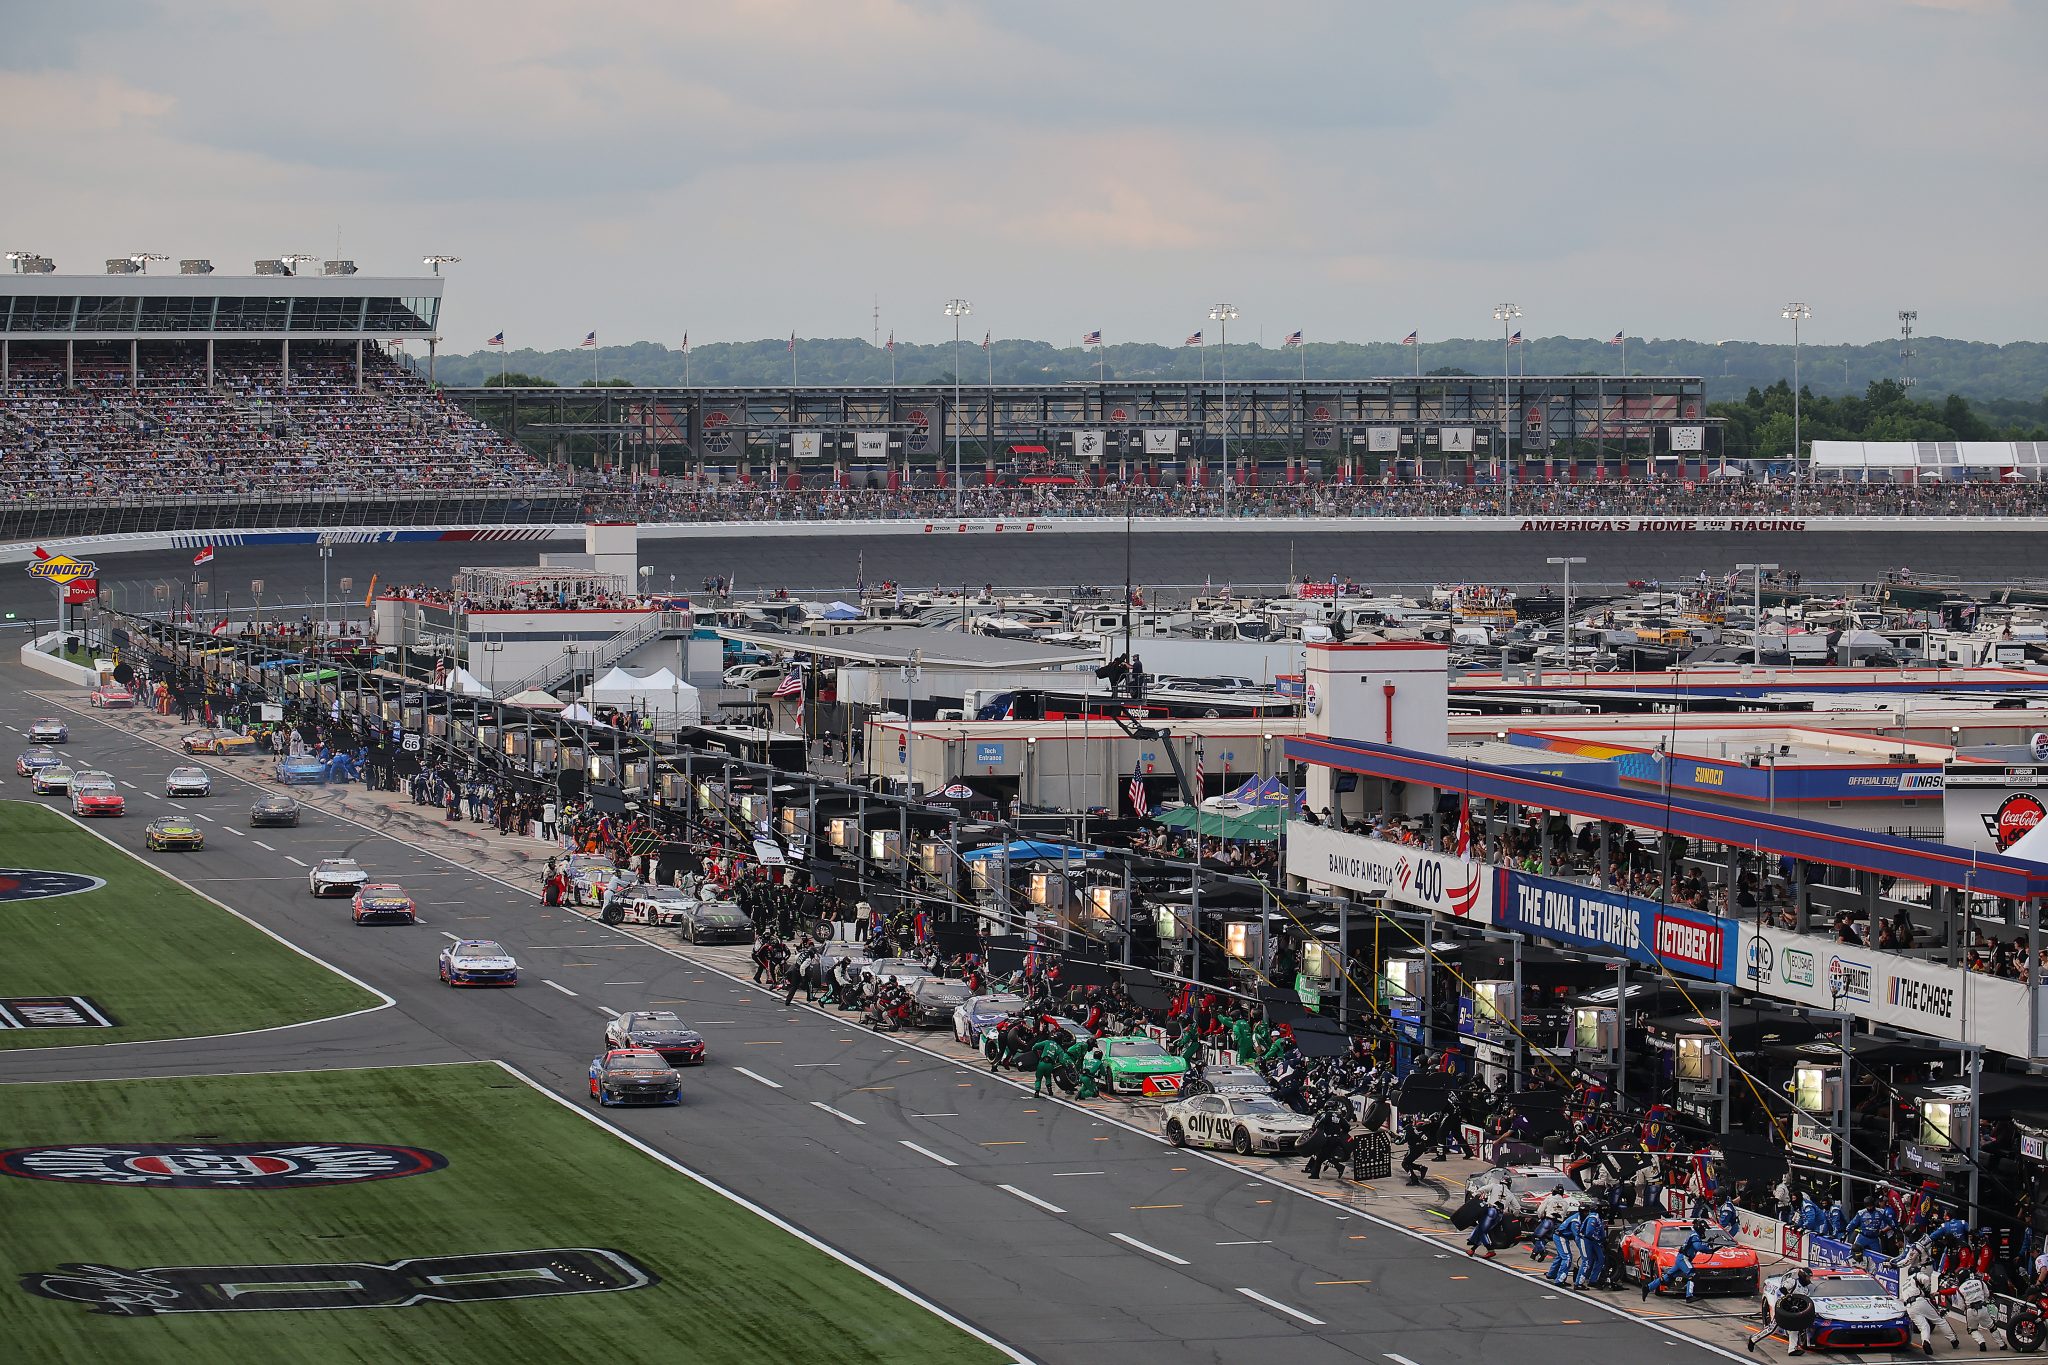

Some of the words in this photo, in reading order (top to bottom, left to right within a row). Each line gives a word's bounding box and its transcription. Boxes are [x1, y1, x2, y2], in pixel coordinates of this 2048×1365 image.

[1520, 520, 1630, 531] AMERICA'S
[1637, 521, 1698, 530] HOME
[1730, 520, 1806, 530] RACING
[316, 531, 384, 544] CHARLOTTE
[386, 530, 398, 542] 4
[34, 564, 92, 576] SUNOCO
[404, 740, 418, 748] 66
[1694, 766, 1724, 786] SUNOCO
[1848, 776, 1881, 786] OFFICIAL
[1882, 776, 1900, 784] FUEL
[2001, 810, 2040, 826] Coca-Cola
[1329, 854, 1350, 876] BANK
[1350, 860, 1360, 880] OF
[1361, 863, 1392, 886] AMERICA
[1414, 858, 1442, 904] 400
[634, 902, 646, 918] 42
[1518, 884, 1542, 926] THE
[1544, 890, 1576, 935] OVAL
[1578, 898, 1640, 950] RETURNS
[1656, 920, 1706, 961] OCTOBER
[1709, 932, 1720, 964] 11
[1902, 978, 1920, 1010] THE
[1920, 984, 1954, 1018] CHASE
[1188, 1114, 1214, 1139] ally
[1216, 1118, 1232, 1140] 48
[2022, 1136, 2036, 1155] Mobil
[22, 1147, 173, 1182] SALUTES
[256, 1146, 400, 1179] NASCAR
